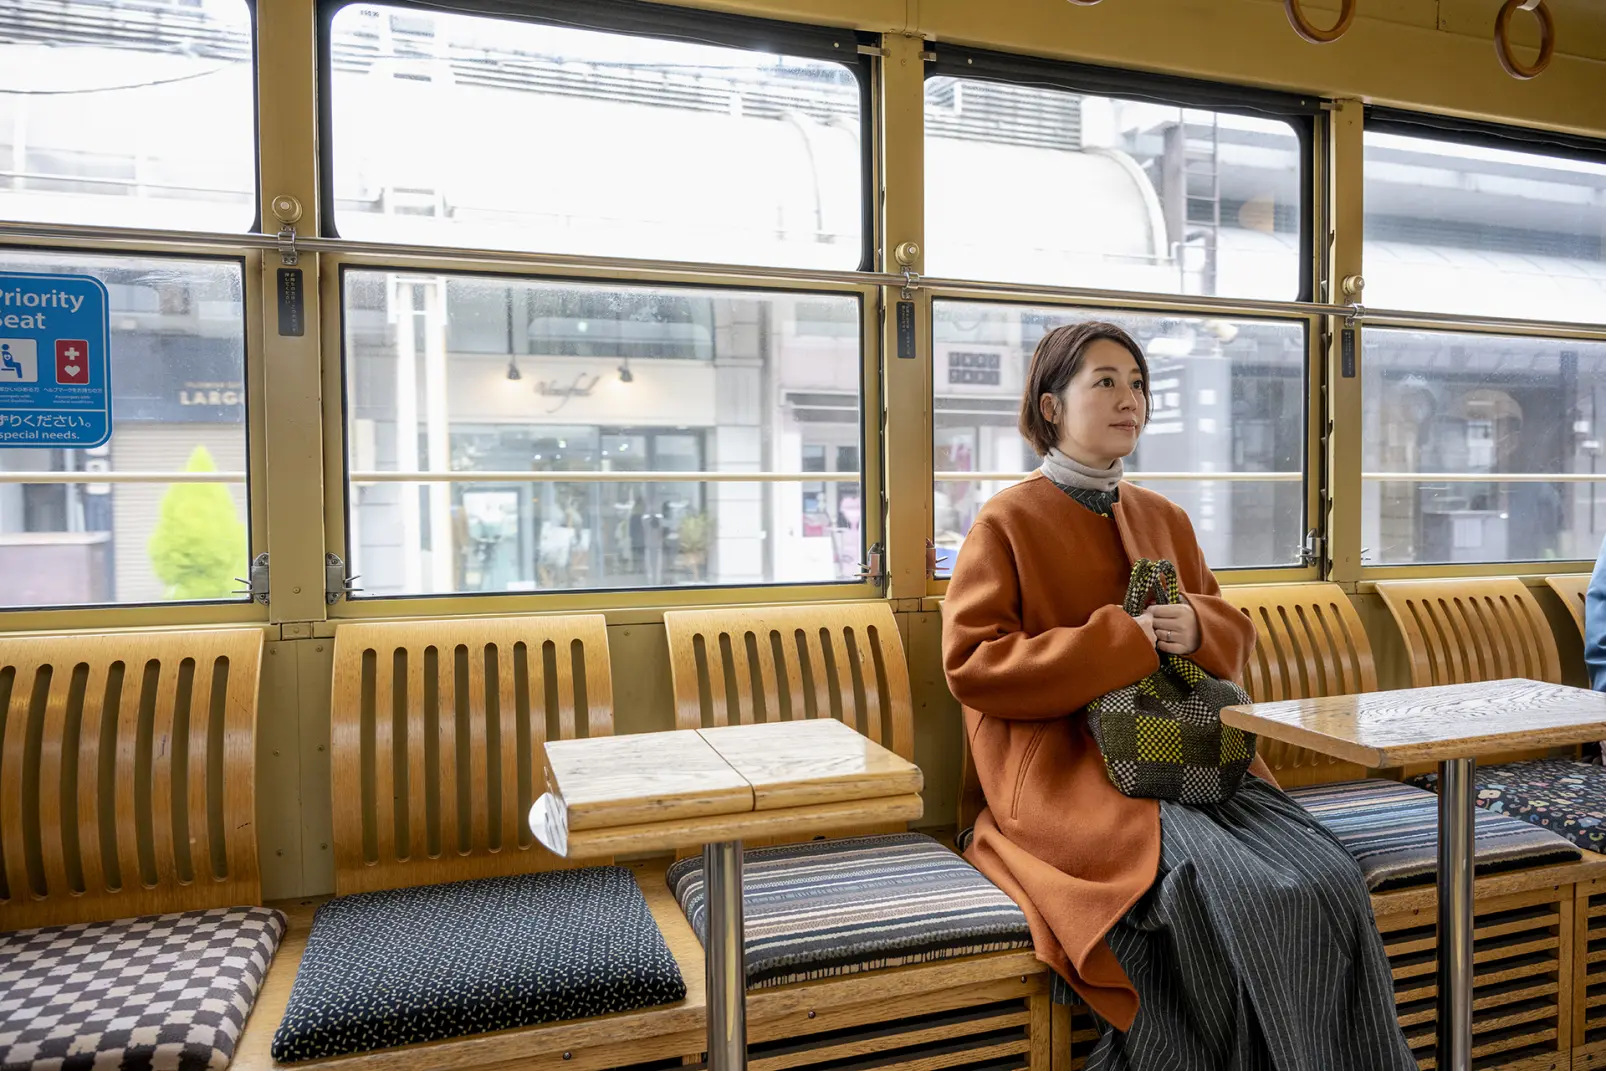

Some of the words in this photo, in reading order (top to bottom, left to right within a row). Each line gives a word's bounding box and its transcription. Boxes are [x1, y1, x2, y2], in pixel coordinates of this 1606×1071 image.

[0, 310, 46, 329] eat
[0, 430, 38, 440] special
[42, 430, 80, 440] needs.
